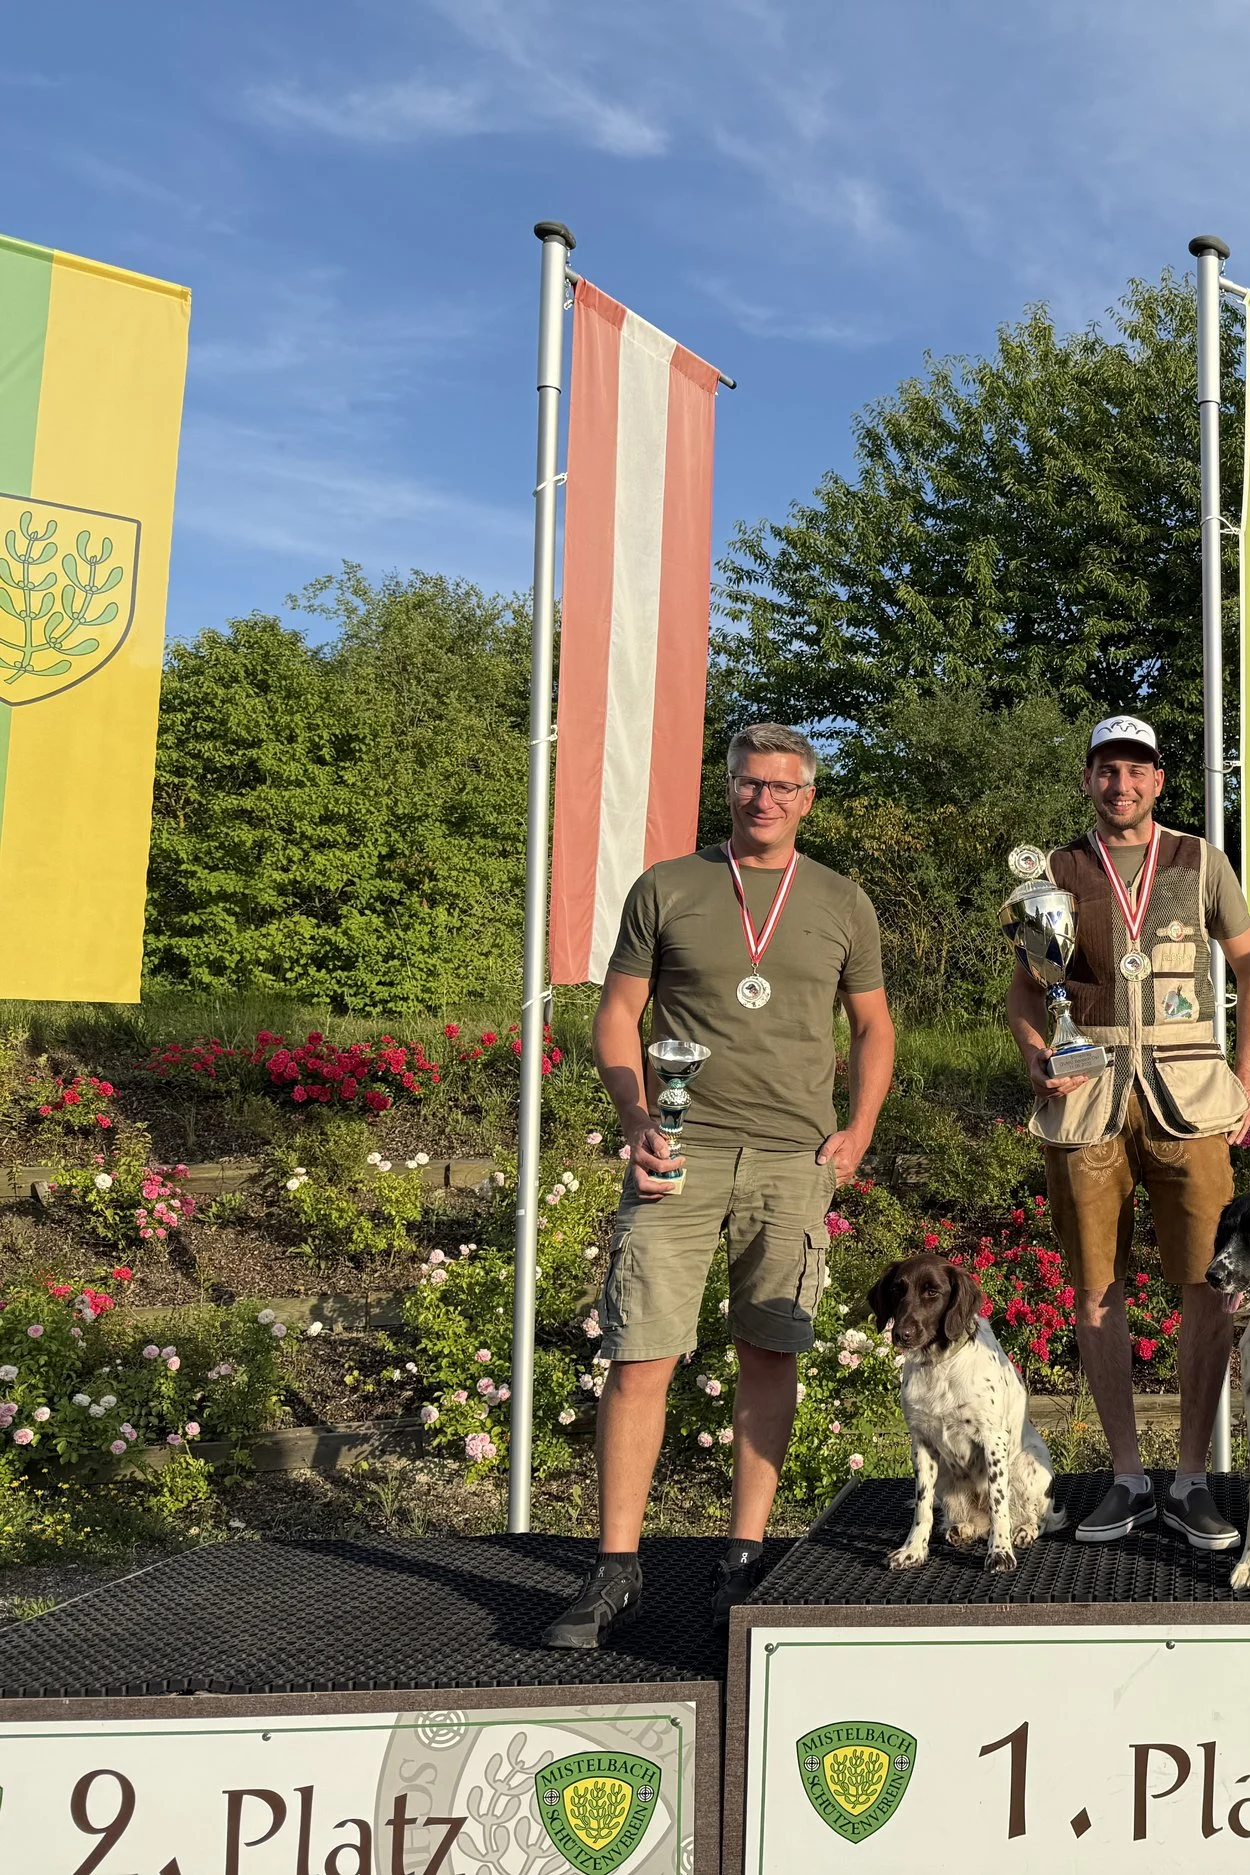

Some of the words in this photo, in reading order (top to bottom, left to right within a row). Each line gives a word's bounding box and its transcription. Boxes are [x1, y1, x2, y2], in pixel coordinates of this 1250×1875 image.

[540, 1758, 657, 1788] MISTELBACH
[802, 1727, 913, 1754] MISTELBACH
[807, 1772, 905, 1835] SCHÜTZENVEREIN
[978, 1720, 1092, 1840] 1.
[221, 1784, 470, 1875] Platz
[546, 1804, 649, 1871] SCHÜTZENVEREIN
